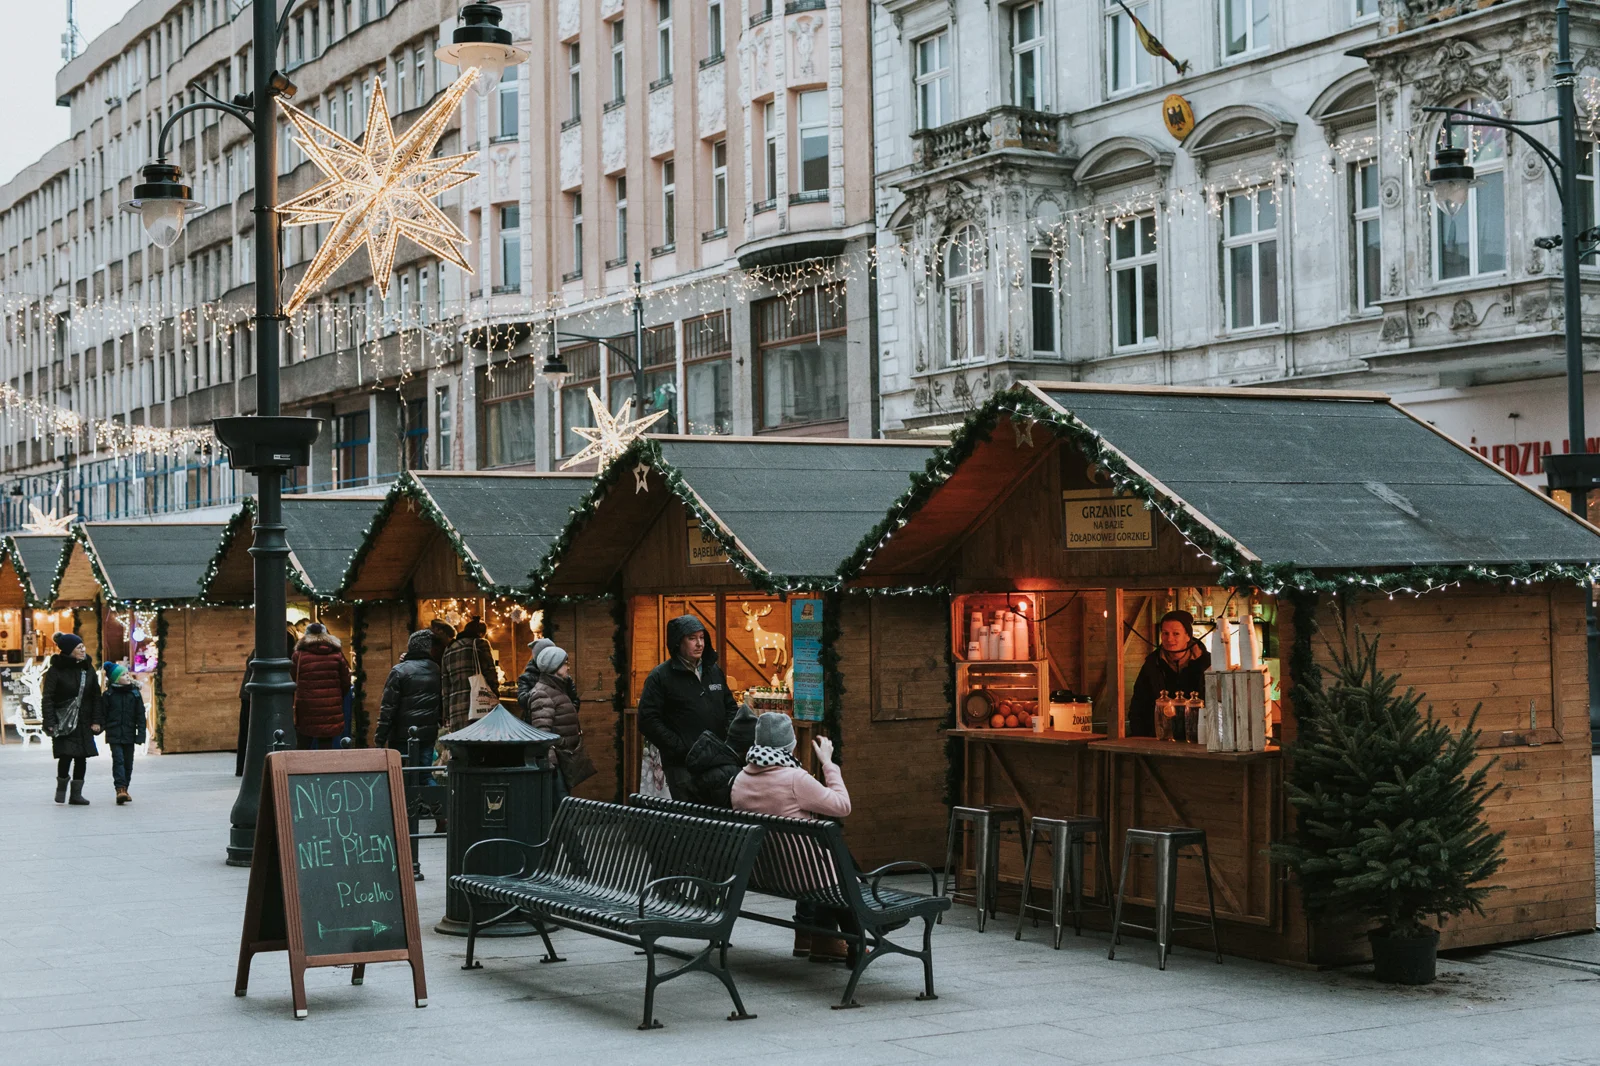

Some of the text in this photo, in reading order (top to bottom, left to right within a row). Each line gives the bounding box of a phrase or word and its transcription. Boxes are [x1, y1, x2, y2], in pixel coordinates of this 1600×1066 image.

[1082, 504, 1133, 519] GRZANIEC
[1093, 520, 1124, 530] NA BAZIE
[1070, 531, 1150, 544] ŻOŁĄDKOWEJ GORZKIEJ
[321, 815, 353, 838] TU
[353, 881, 394, 904] Coelho
